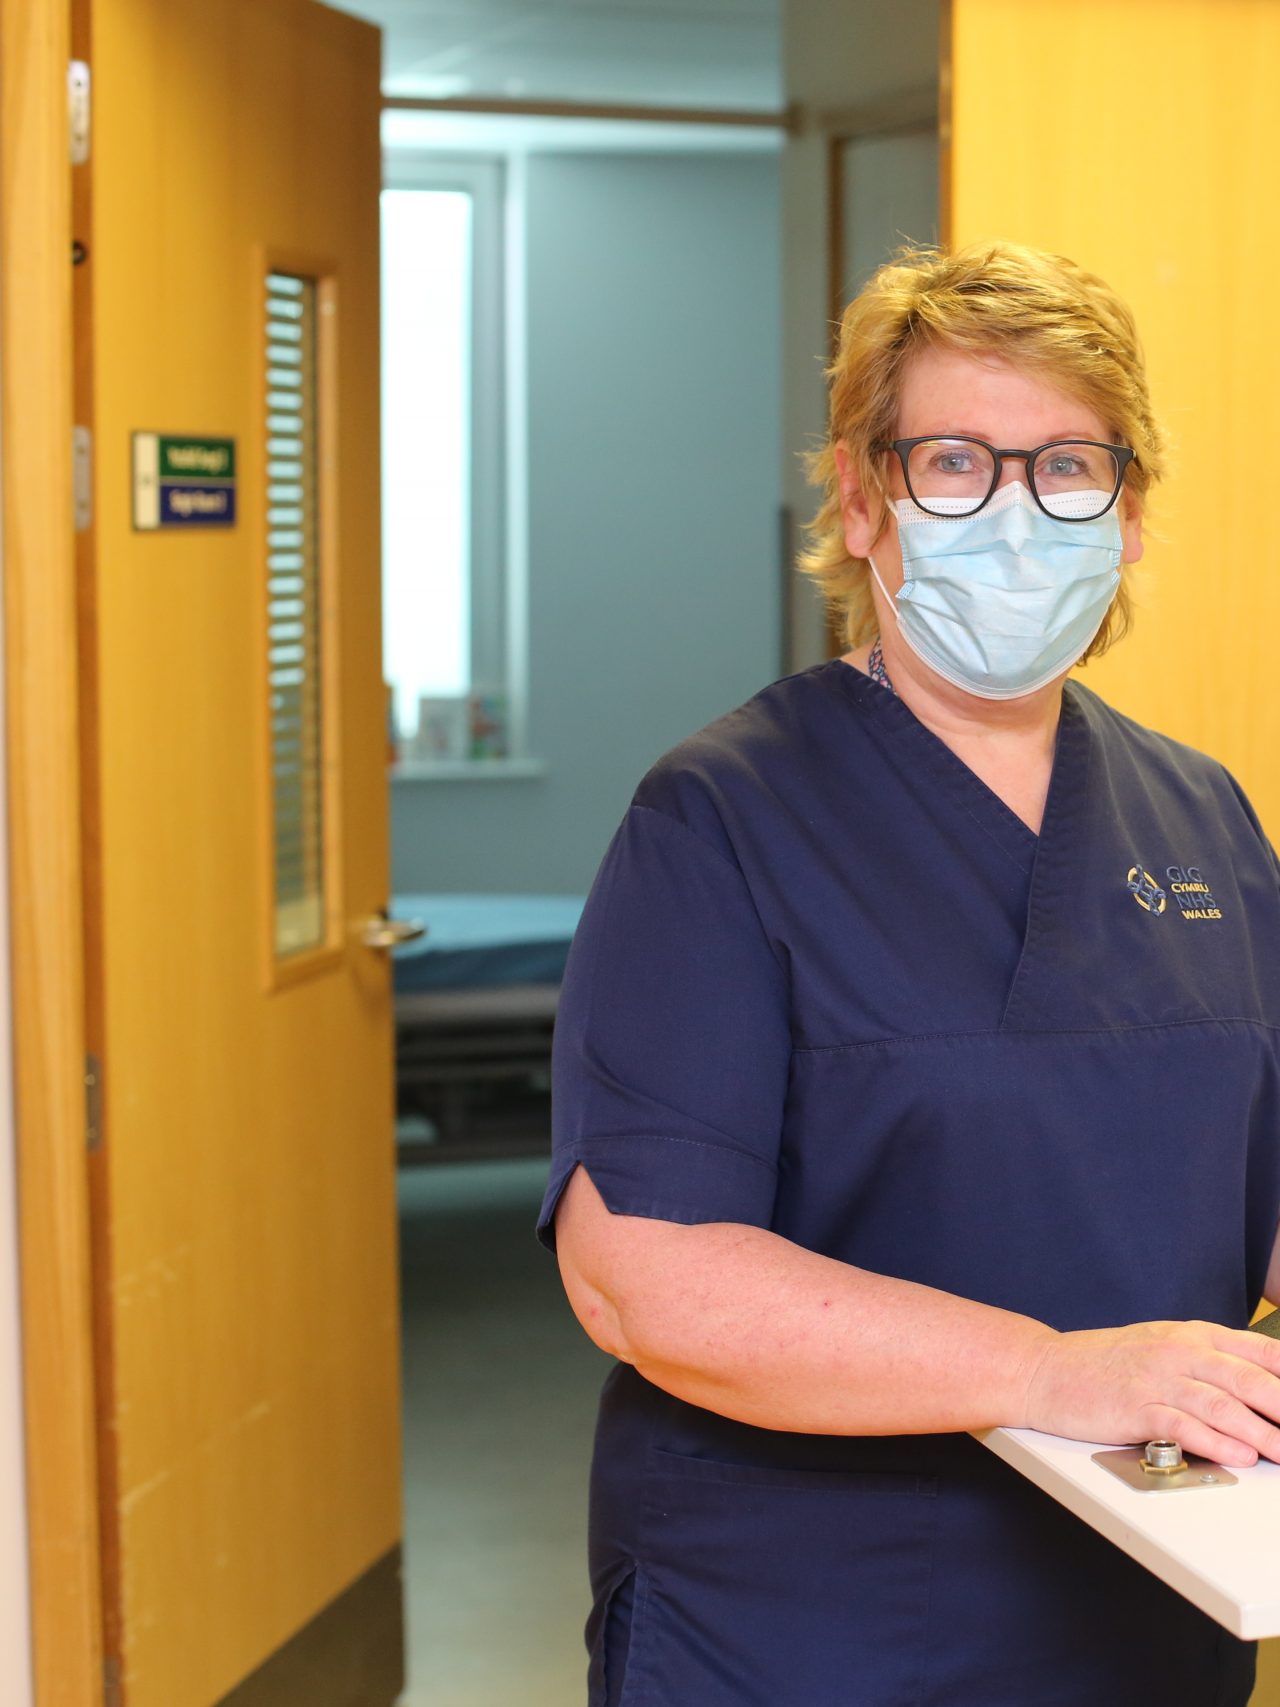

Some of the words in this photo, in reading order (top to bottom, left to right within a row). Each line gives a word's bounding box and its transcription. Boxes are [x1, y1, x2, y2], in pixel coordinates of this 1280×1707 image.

[1166, 866, 1204, 883] GIG
[1171, 882, 1210, 893] CYMRU
[1175, 893, 1218, 909] NHS
[1182, 908, 1223, 920] WALES
